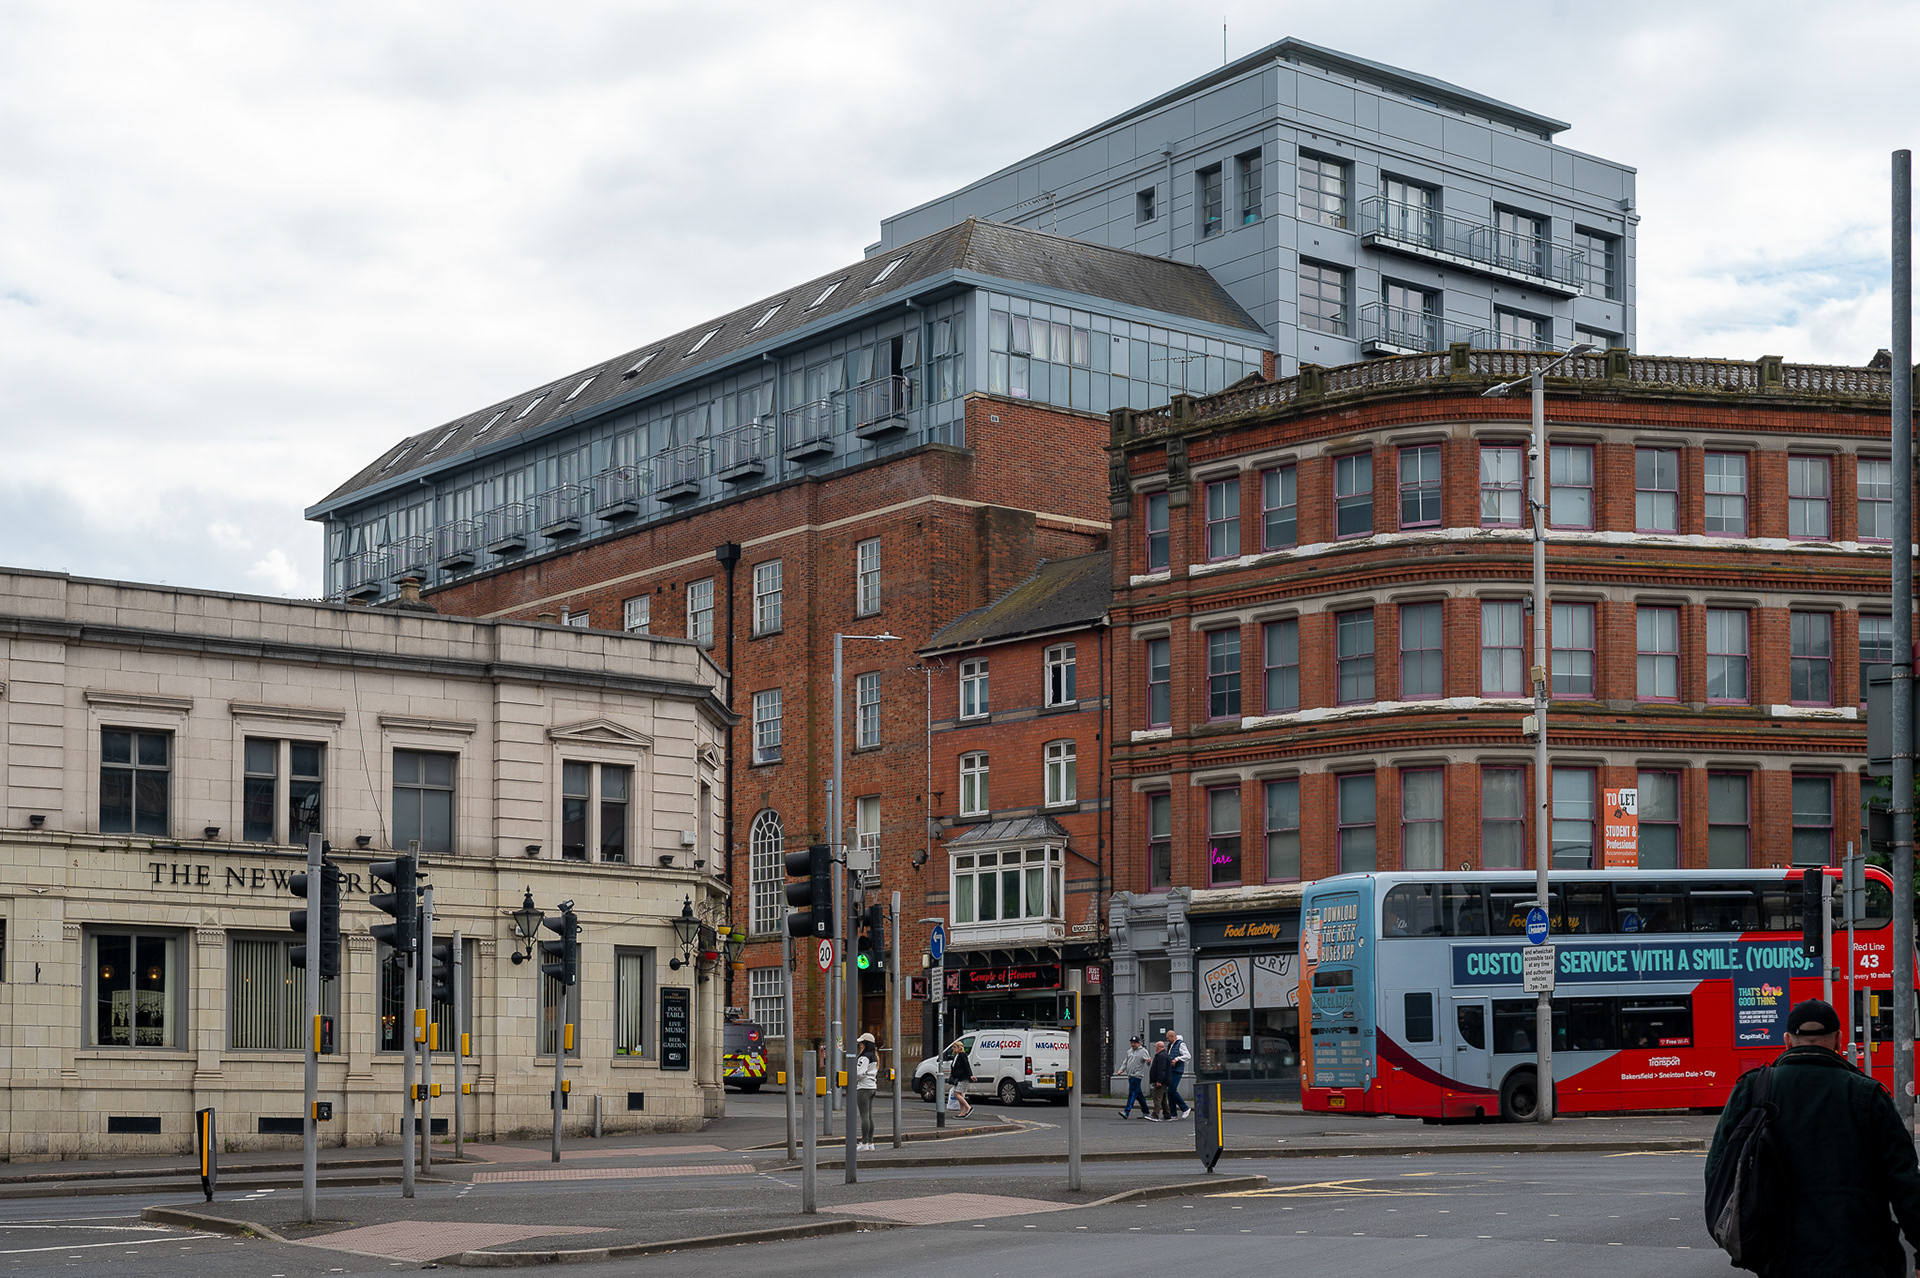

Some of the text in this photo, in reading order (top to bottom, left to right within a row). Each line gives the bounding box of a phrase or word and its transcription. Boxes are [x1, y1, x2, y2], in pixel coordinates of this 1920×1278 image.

[1606, 793, 1635, 806] TO LET
[1606, 825, 1636, 837] STUDENT &
[1606, 840, 1636, 849] Professional
[149, 862, 211, 886] THE
[1323, 905, 1357, 922] DOWNLOAD
[1224, 923, 1280, 938] Food Factory
[1322, 926, 1335, 944] THE
[820, 946, 830, 961] 20
[1322, 944, 1354, 962] BUSES APP
[1853, 943, 1867, 951] Red
[1560, 950, 1628, 973] SERVICE
[1631, 949, 1673, 972] WITH
[1678, 949, 1694, 970] A
[1695, 948, 1743, 970] SMILE.
[1860, 954, 1879, 968] 43
[970, 970, 1036, 983] Temple of Heaven
[1208, 964, 1234, 983] FOOD
[1211, 973, 1237, 994] FACT
[1738, 983, 1783, 996] THAT'S One
[1214, 982, 1240, 1003] ORY
[1739, 996, 1777, 1006] GOOD THING.
[980, 1041, 1021, 1050] MEGACLOSE
[1649, 1059, 1680, 1067] Transport
